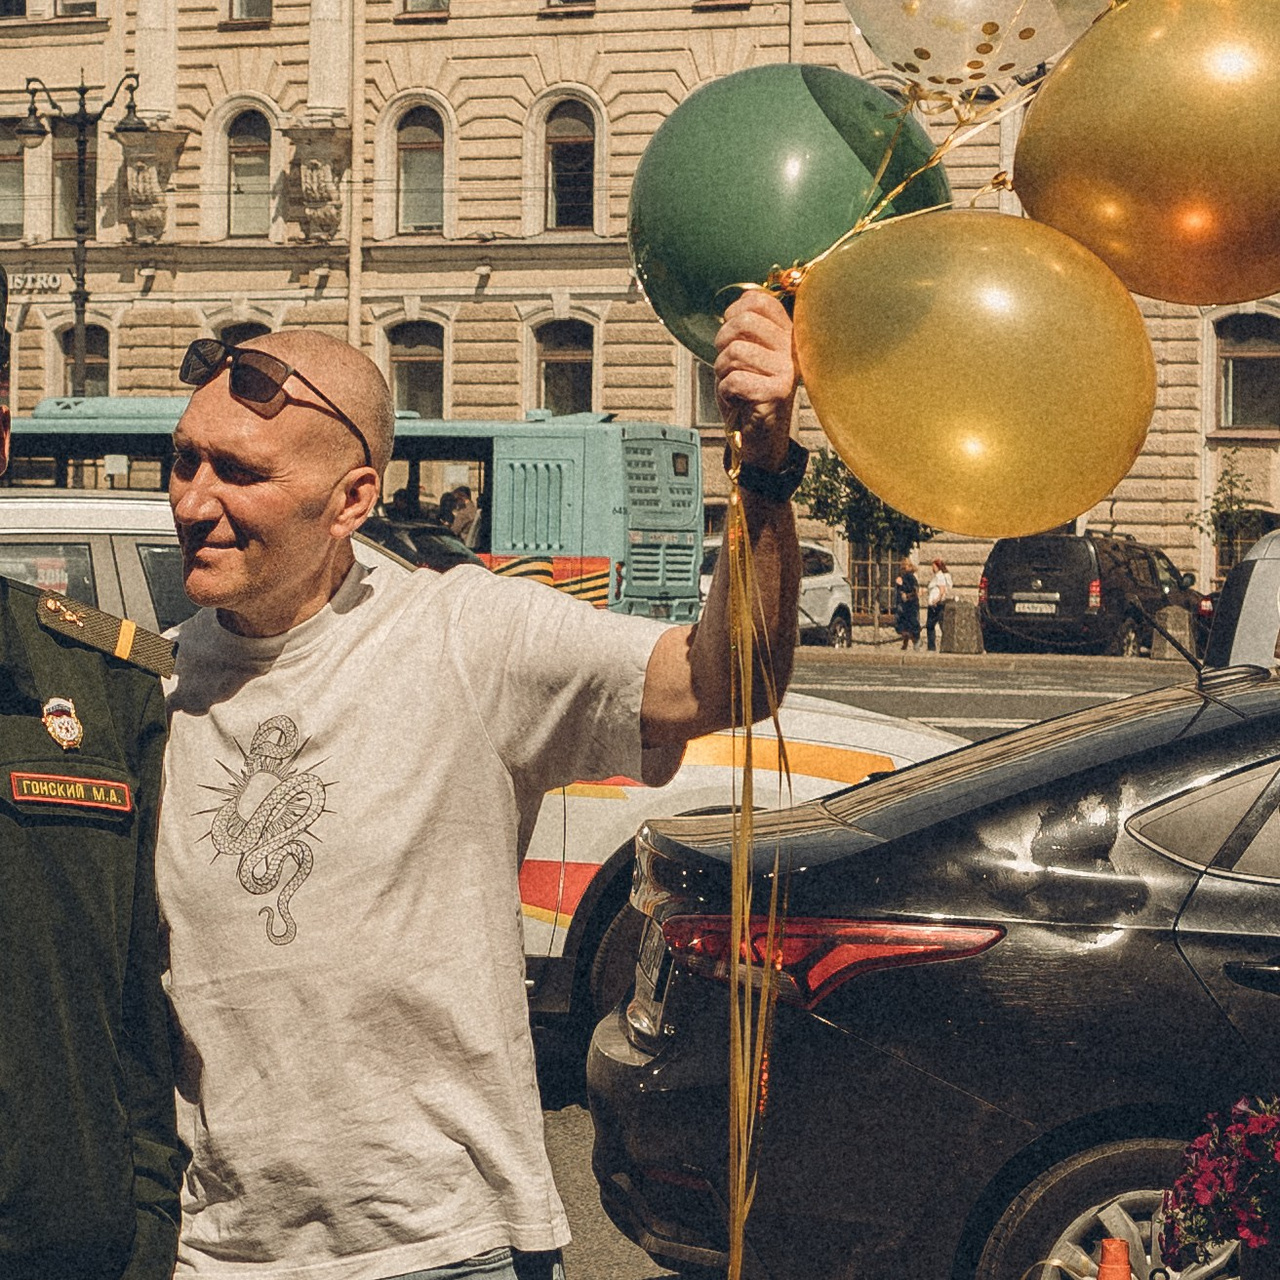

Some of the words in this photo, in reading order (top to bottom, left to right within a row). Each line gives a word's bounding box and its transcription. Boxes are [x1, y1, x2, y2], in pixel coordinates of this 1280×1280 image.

[7, 273, 61, 289] ISTRO
[22, 780, 85, 799] ГОНСКИЙ
[92, 786, 122, 804] М.А.
